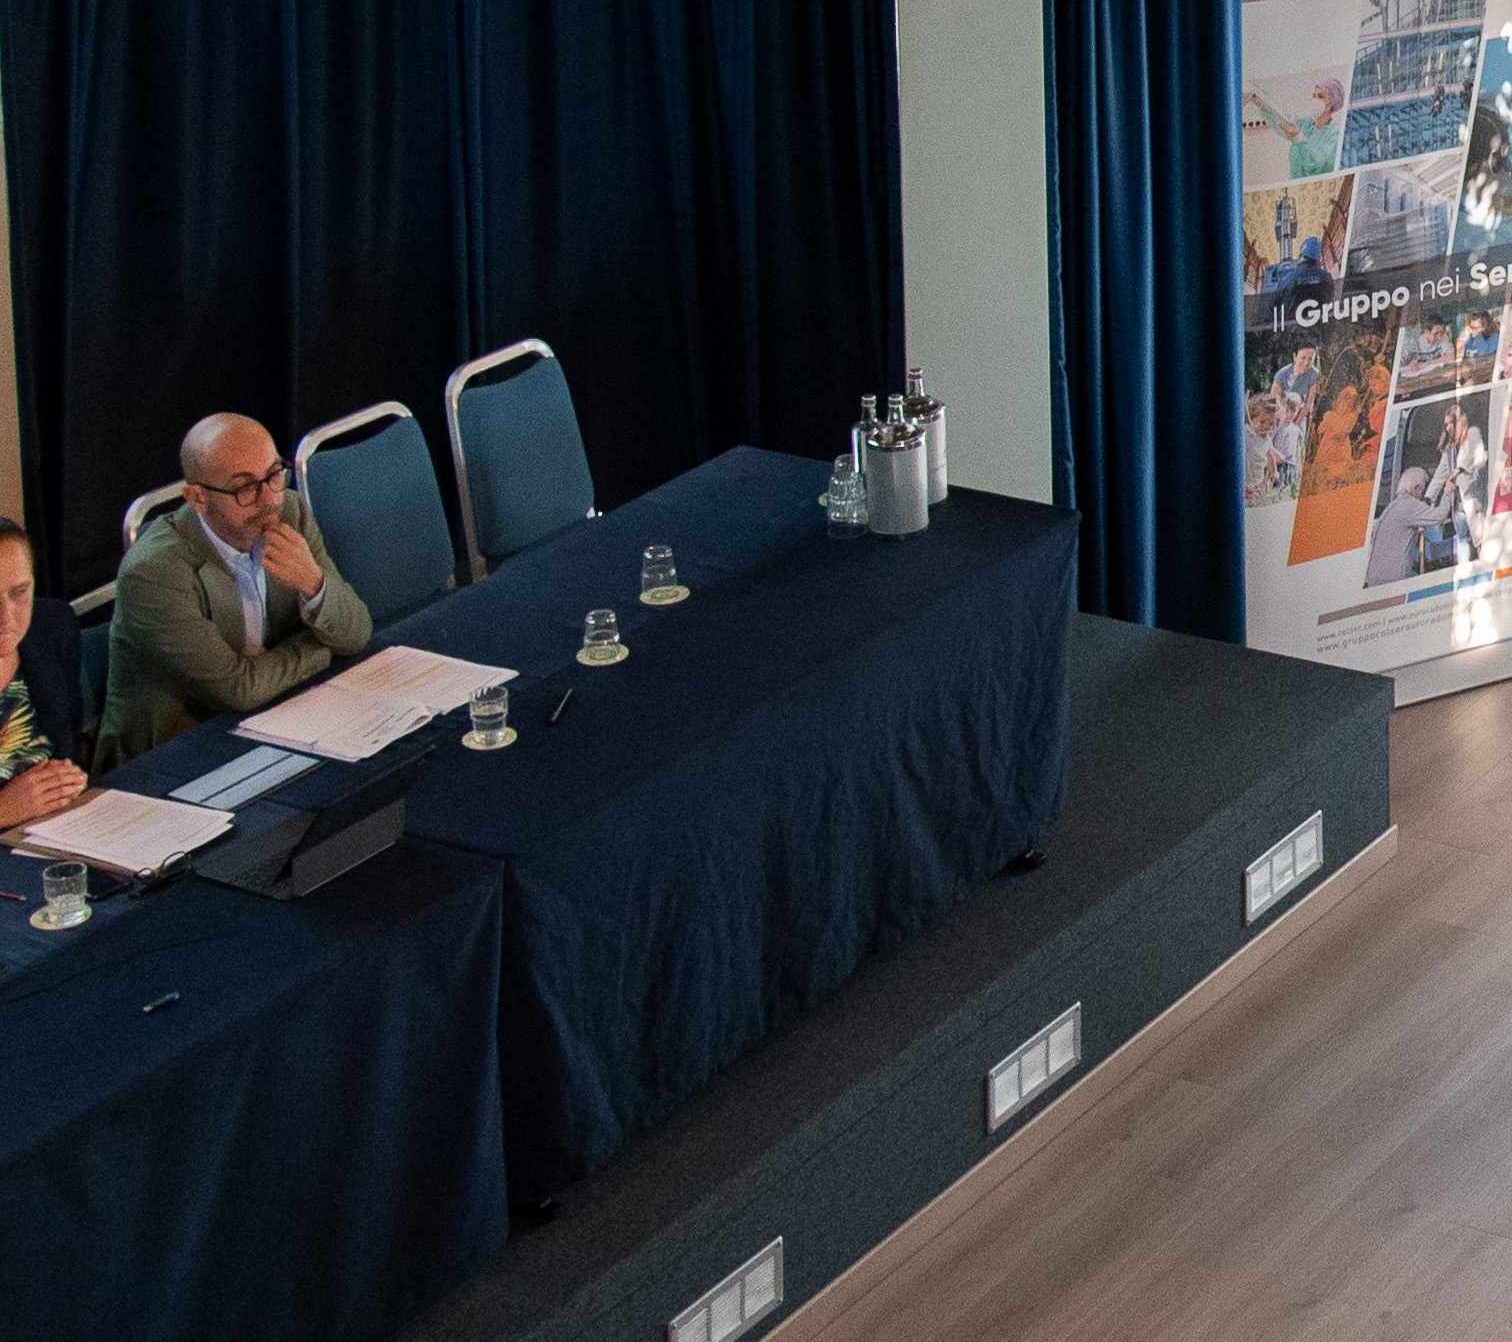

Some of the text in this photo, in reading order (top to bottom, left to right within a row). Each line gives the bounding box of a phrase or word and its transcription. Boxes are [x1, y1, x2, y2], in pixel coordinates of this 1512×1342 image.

[1273, 304, 1286, 333] Il
[1295, 285, 1410, 327] Gruppo
[1419, 267, 1462, 302] nei
